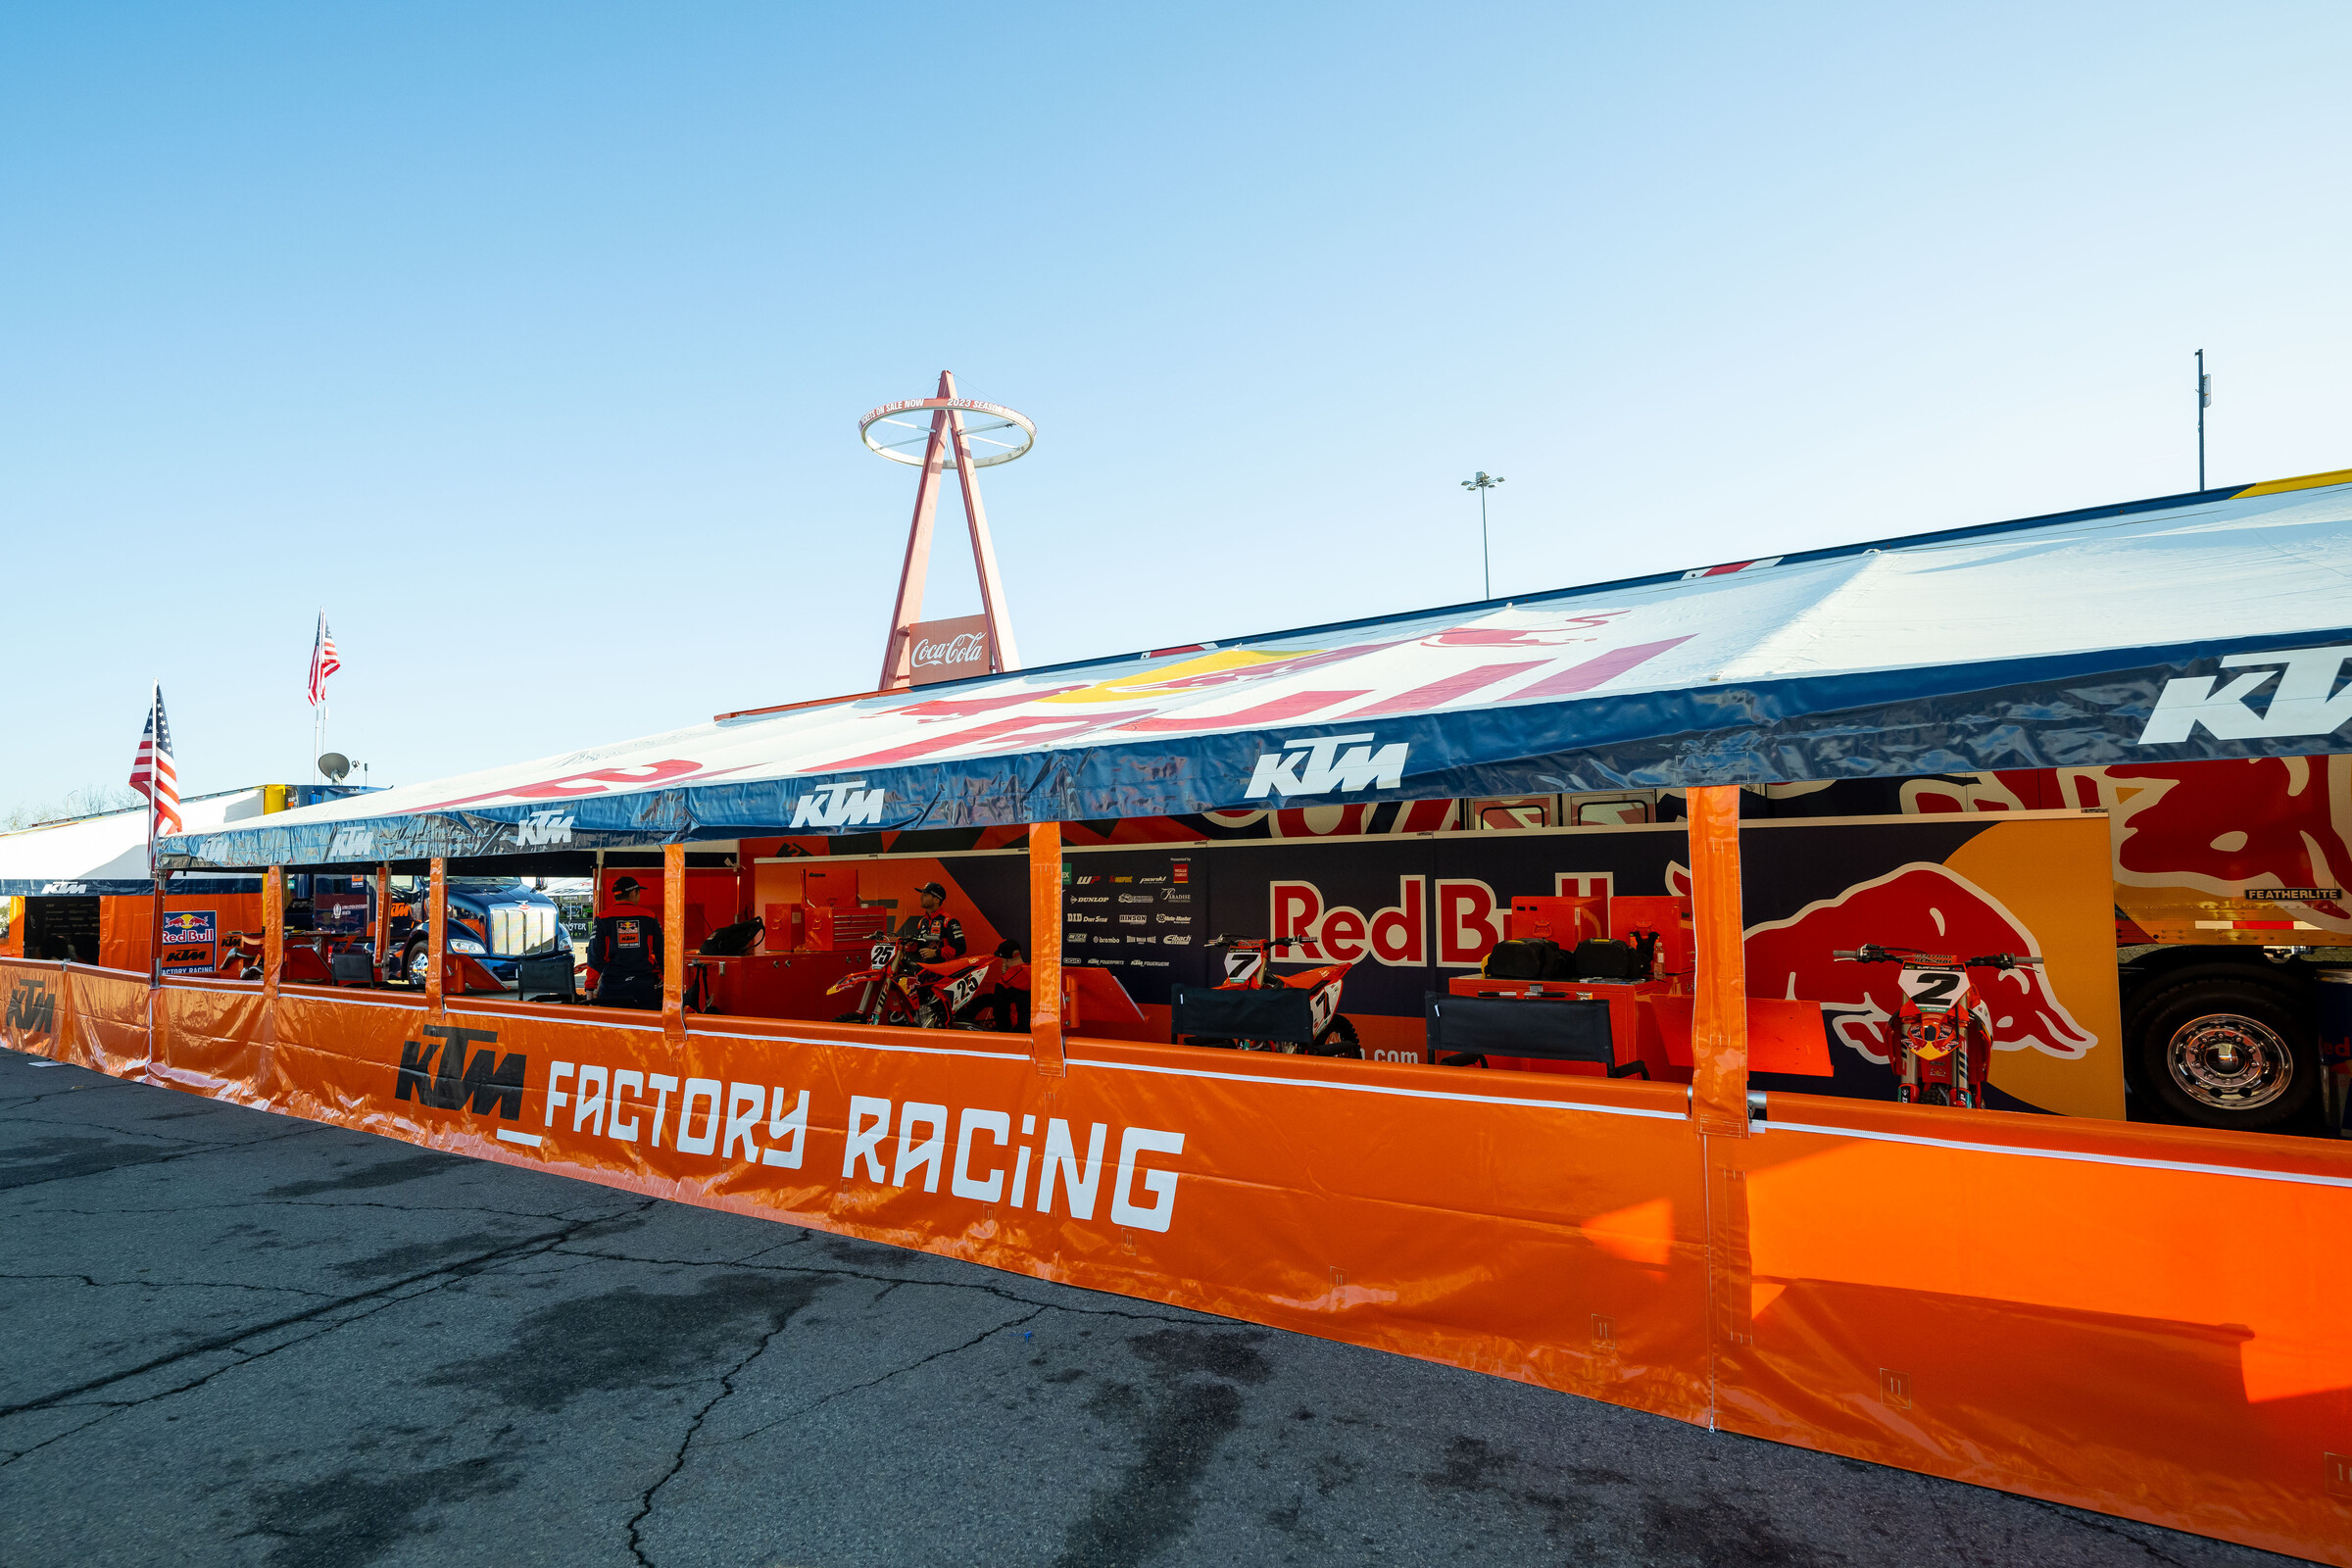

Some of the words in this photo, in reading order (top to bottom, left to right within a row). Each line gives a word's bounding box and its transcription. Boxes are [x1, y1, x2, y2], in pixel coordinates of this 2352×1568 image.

[876, 407, 885, 416] ON
[886, 402, 903, 413] SALE
[905, 399, 924, 409] NOW
[948, 398, 971, 408] 2023
[911, 632, 987, 667] Coca-Cola
[2137, 644, 2352, 745] KT
[1244, 732, 1409, 799] KTM
[789, 780, 885, 828] KTM
[330, 825, 374, 857] KTM
[516, 808, 575, 847] KTM
[197, 836, 229, 862] KTM
[41, 881, 87, 895] KTM
[2248, 890, 2338, 900] FEATHERLITE
[1272, 875, 1425, 965] Red
[163, 930, 186, 942] Red
[188, 929, 214, 941] Bull
[221, 936, 242, 947] KTM
[167, 949, 207, 961] KTM
[871, 946, 894, 964] 25
[1228, 955, 1259, 978] 7
[956, 973, 979, 1001] 25
[1911, 972, 1960, 1006] 2
[6, 979, 56, 1034] KTM
[394, 1024, 527, 1122] KTM
[545, 1060, 810, 1170] FACTORY
